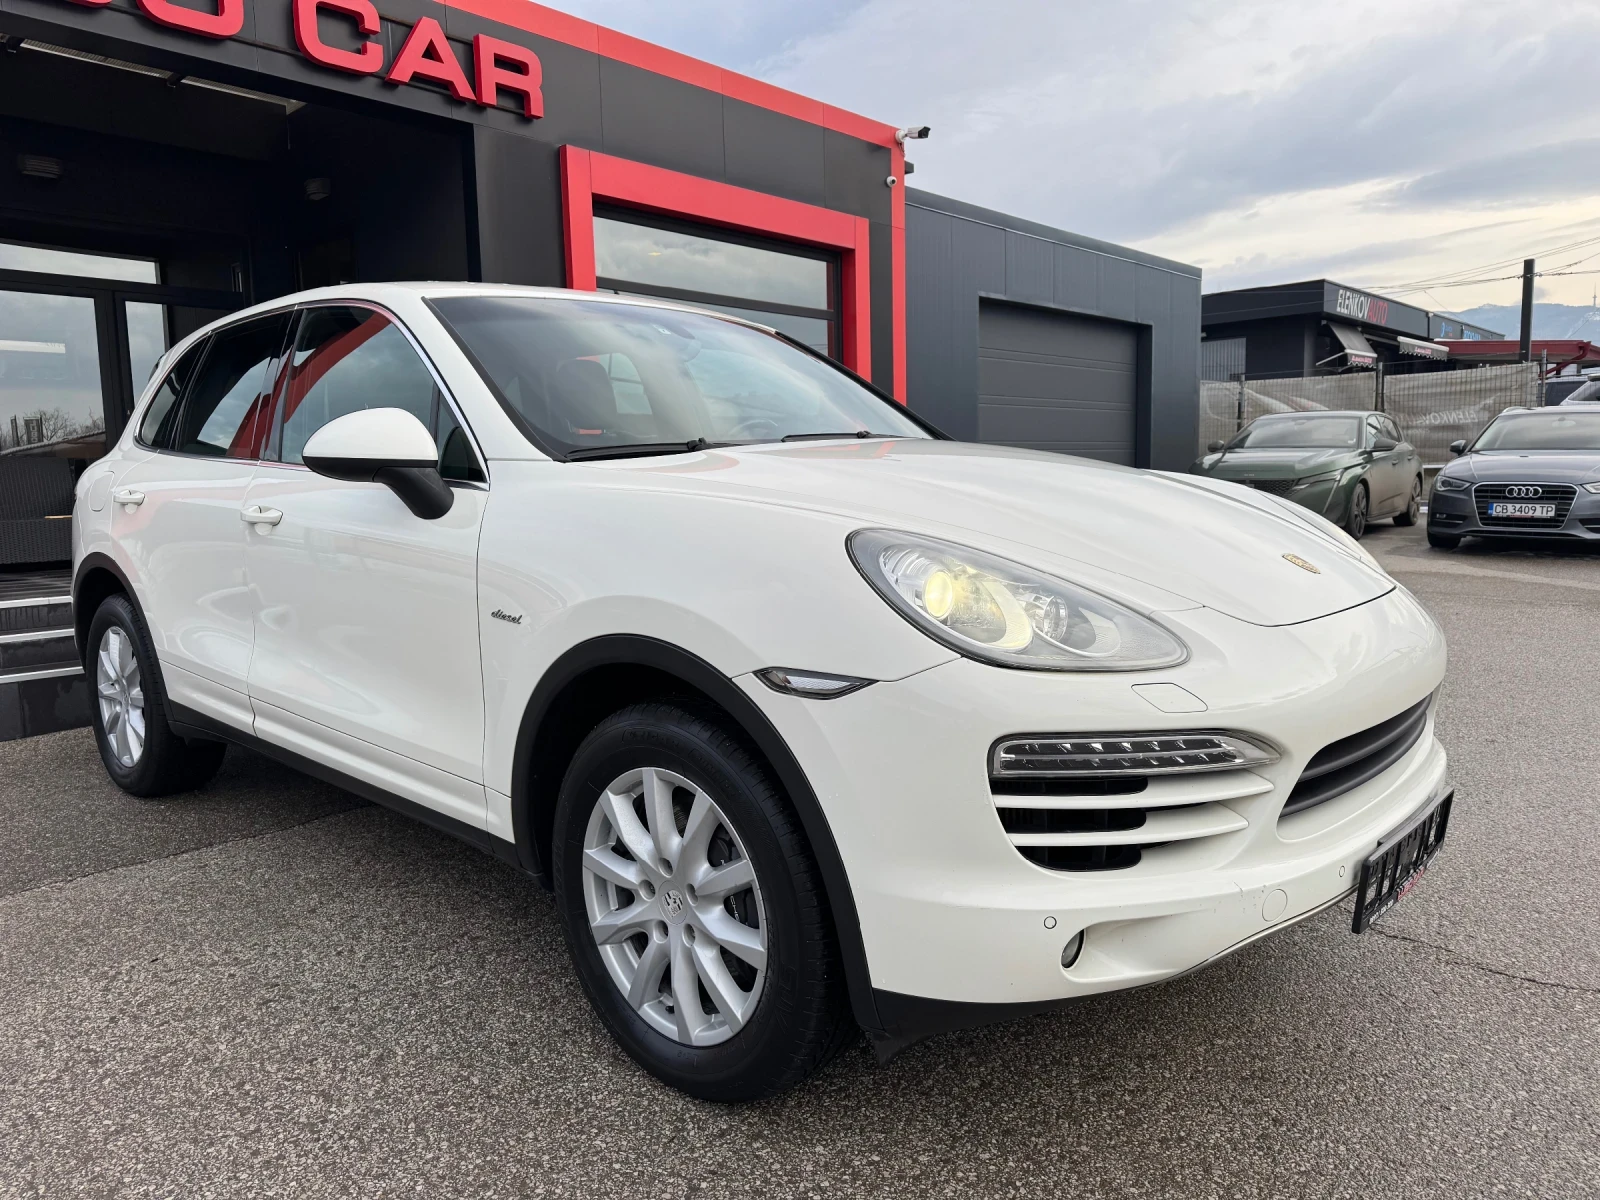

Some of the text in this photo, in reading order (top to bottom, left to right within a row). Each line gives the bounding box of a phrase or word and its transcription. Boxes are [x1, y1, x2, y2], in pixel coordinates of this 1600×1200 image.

[294, 0, 545, 119] CAR
[1494, 504, 1508, 514] CB
[1510, 505, 1537, 515] 3409
[1539, 506, 1554, 516] TP
[491, 609, 523, 625] diesel
